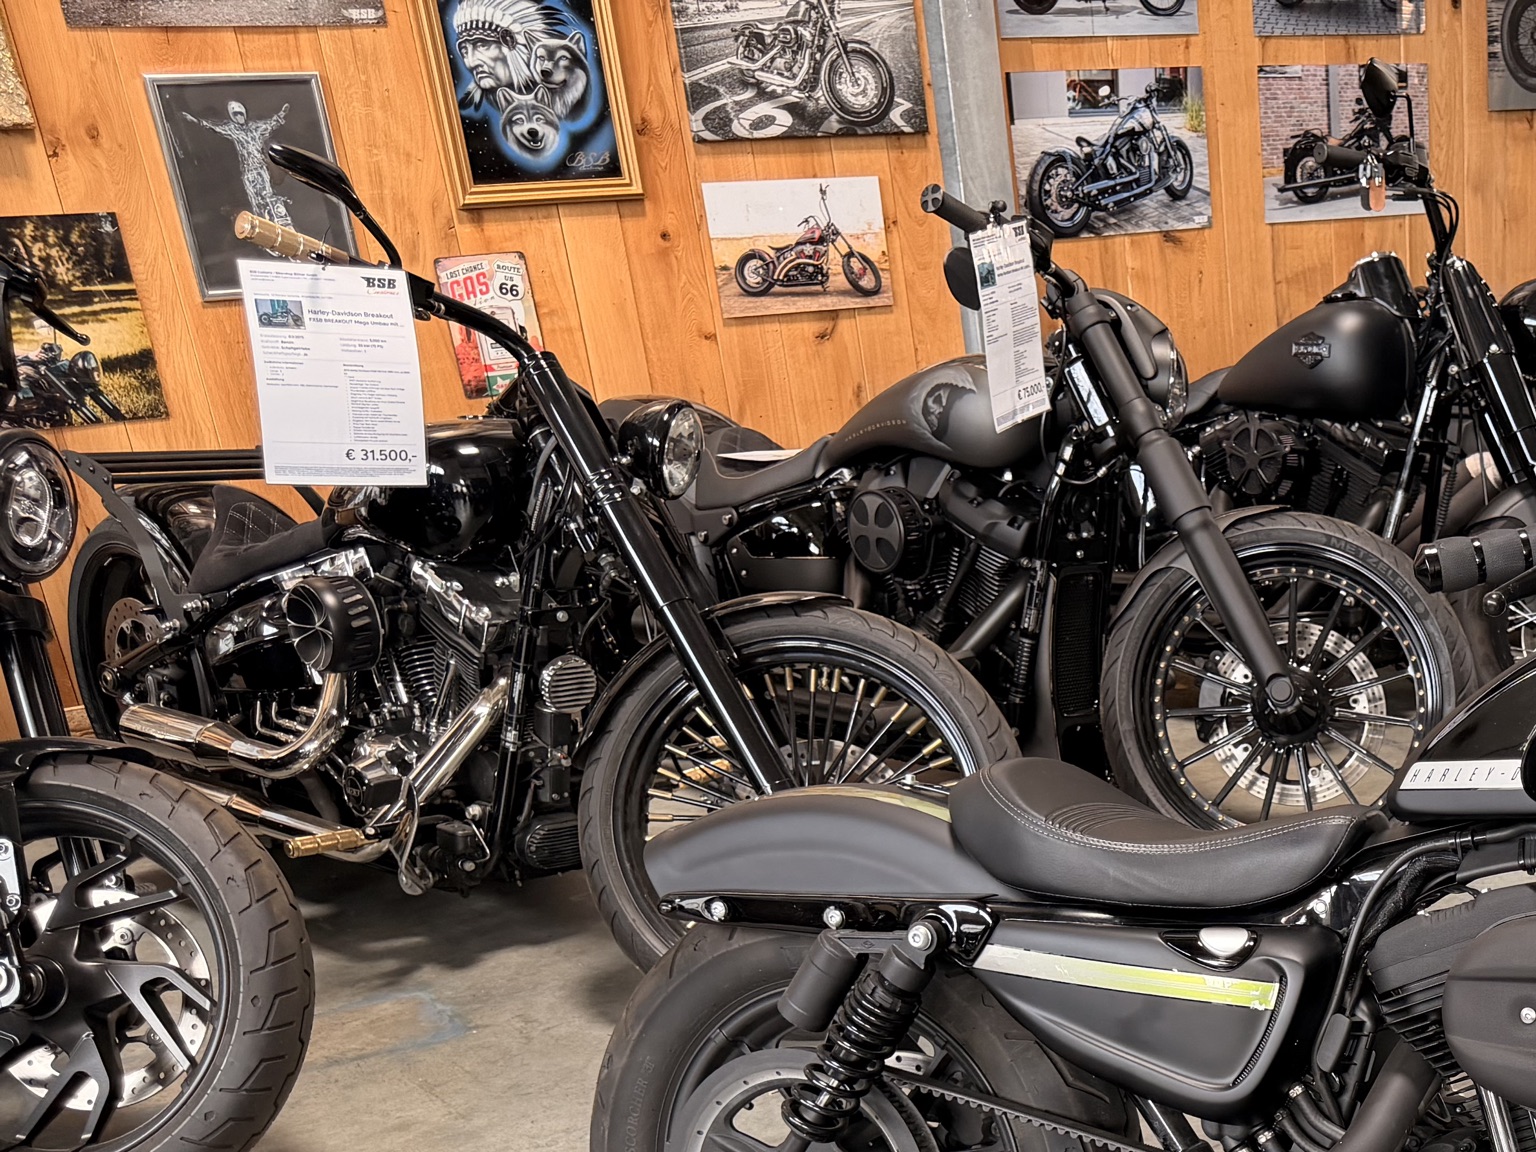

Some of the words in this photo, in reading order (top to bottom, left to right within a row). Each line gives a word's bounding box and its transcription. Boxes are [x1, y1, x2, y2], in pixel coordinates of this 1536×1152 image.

[445, 269, 461, 280] LAST
[462, 262, 485, 276] CHANCE
[496, 263, 521, 274] ROUTE
[361, 276, 397, 289] BSB
[449, 272, 491, 301] GAS
[498, 282, 520, 298] 66
[307, 308, 363, 318] Harley-Davidson
[364, 311, 394, 319] Breakout
[345, 449, 356, 461] €
[360, 449, 418, 463] 31.500,-
[1329, 537, 1415, 599] METZELER
